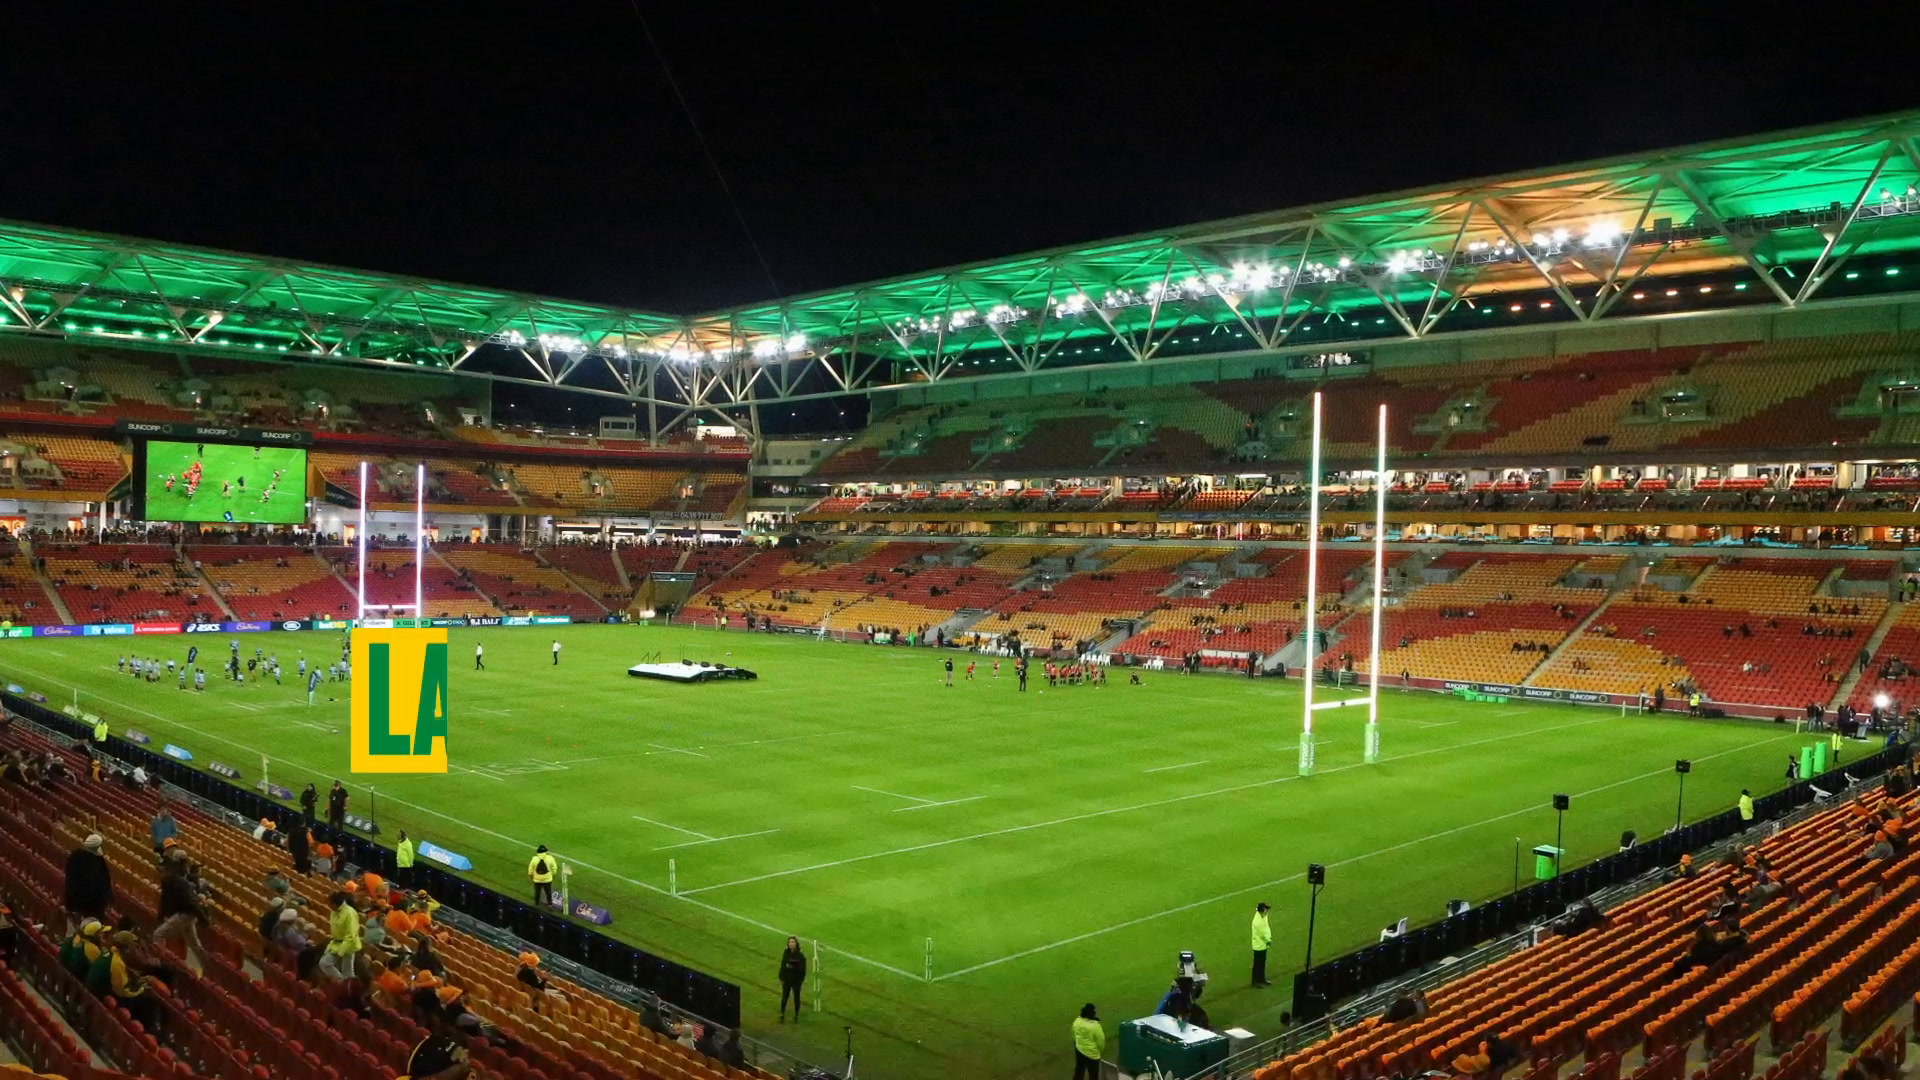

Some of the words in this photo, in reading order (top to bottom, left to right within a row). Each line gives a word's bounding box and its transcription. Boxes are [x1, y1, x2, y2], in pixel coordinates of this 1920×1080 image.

[127, 423, 161, 432] SUNCORP
[196, 427, 228, 436] SUNCORP
[261, 431, 292, 440] SUNCORP
[43, 626, 73, 636] Cadbury
[1445, 682, 1470, 690] SUNCORP
[1484, 685, 1511, 694] SUNCORP
[1525, 689, 1553, 698] SUNCORP
[1569, 693, 1598, 702] SUNCORP
[428, 846, 453, 865] Santos
[576, 902, 599, 921] Cadbury
